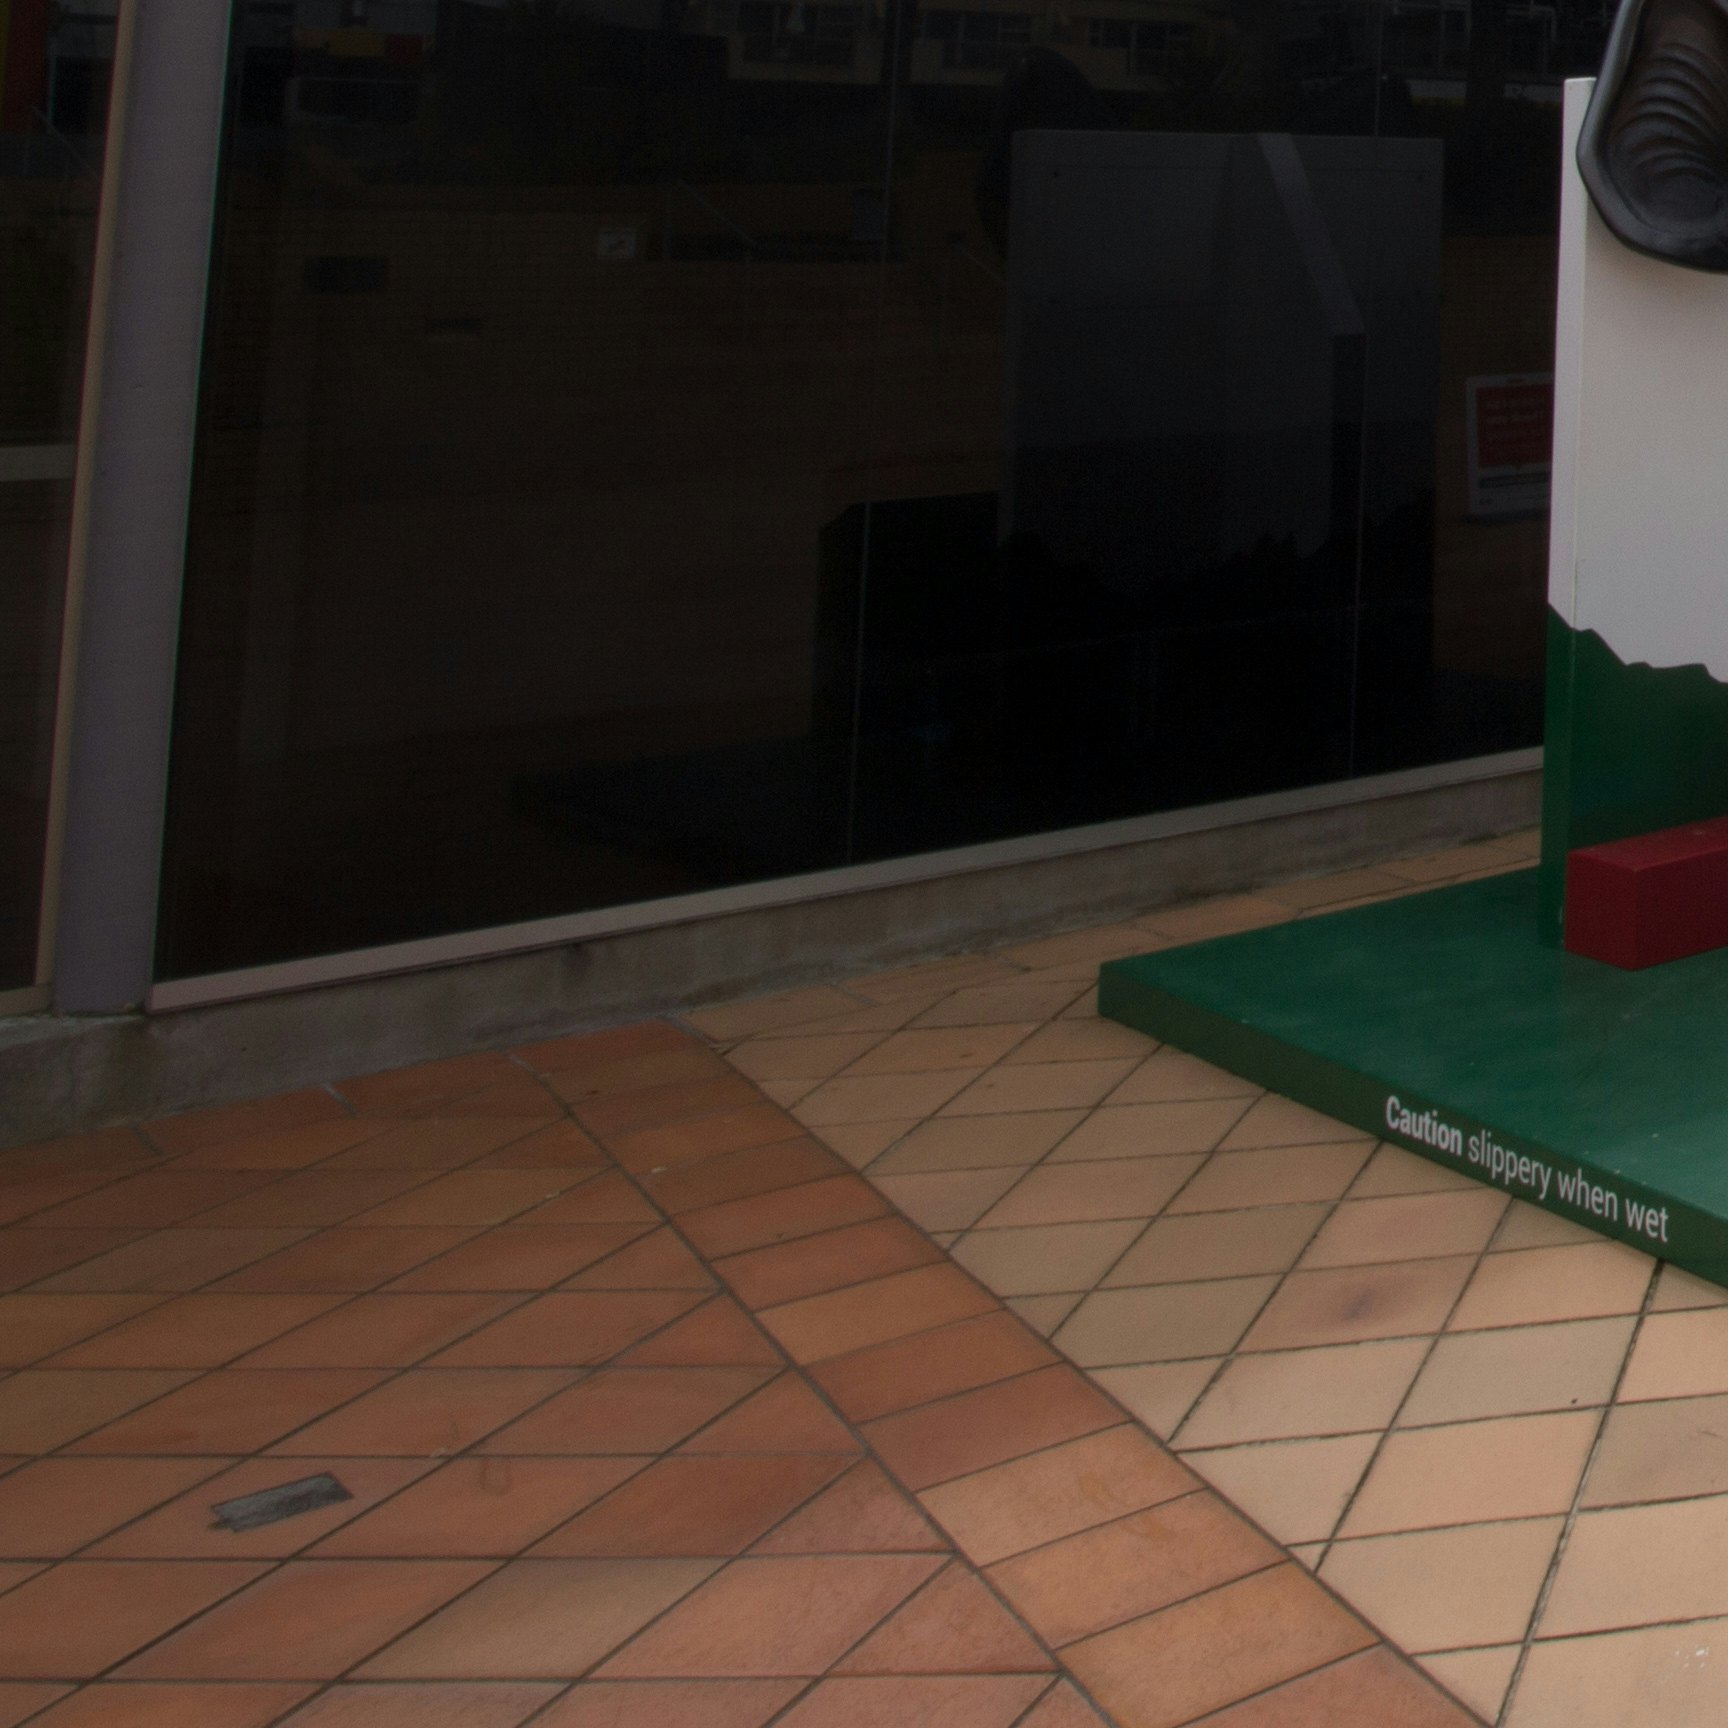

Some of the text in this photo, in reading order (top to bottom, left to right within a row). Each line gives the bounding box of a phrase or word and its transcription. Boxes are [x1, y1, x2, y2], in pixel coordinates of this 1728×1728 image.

[1385, 1095, 1669, 1243] Caution slippery when wet
